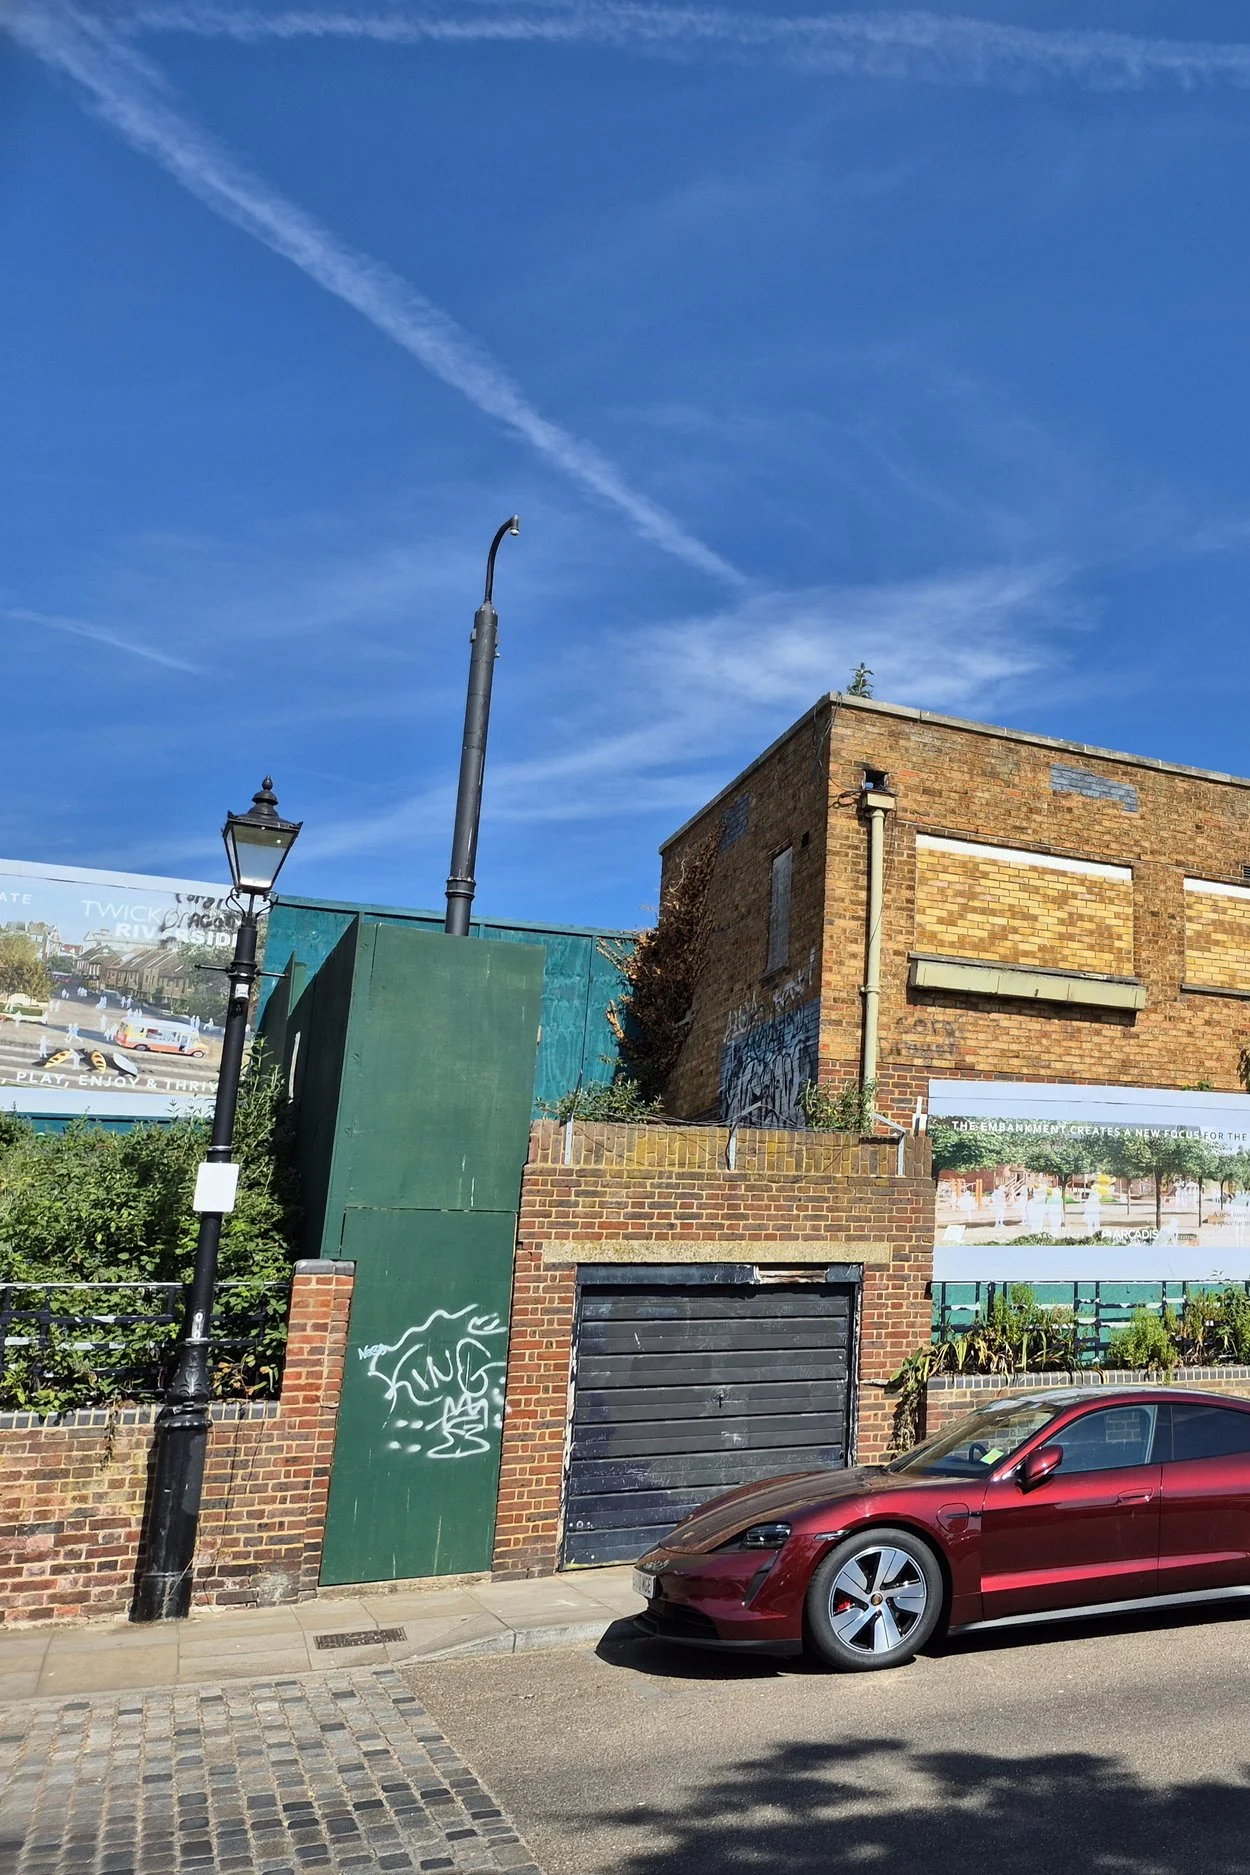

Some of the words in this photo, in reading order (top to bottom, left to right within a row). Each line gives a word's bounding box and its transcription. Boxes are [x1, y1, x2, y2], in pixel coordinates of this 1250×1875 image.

[115, 922, 239, 949] RIVERSID
[16, 1070, 70, 1088] PLAY,
[78, 1074, 140, 1088] ENJOY
[145, 1078, 157, 1089] &
[164, 1078, 218, 1092] THRIV
[951, 1120, 976, 1132] THE
[980, 1121, 1066, 1135] EMBANKMENT
[1069, 1125, 1121, 1137] CREATES
[1123, 1128, 1133, 1137] A
[1135, 1128, 1161, 1138] NEW
[1164, 1129, 1200, 1140] FOCUS
[1203, 1131, 1225, 1141] FOR
[1228, 1132, 1247, 1142] THE
[1112, 1229, 1160, 1241] ARCADIS
